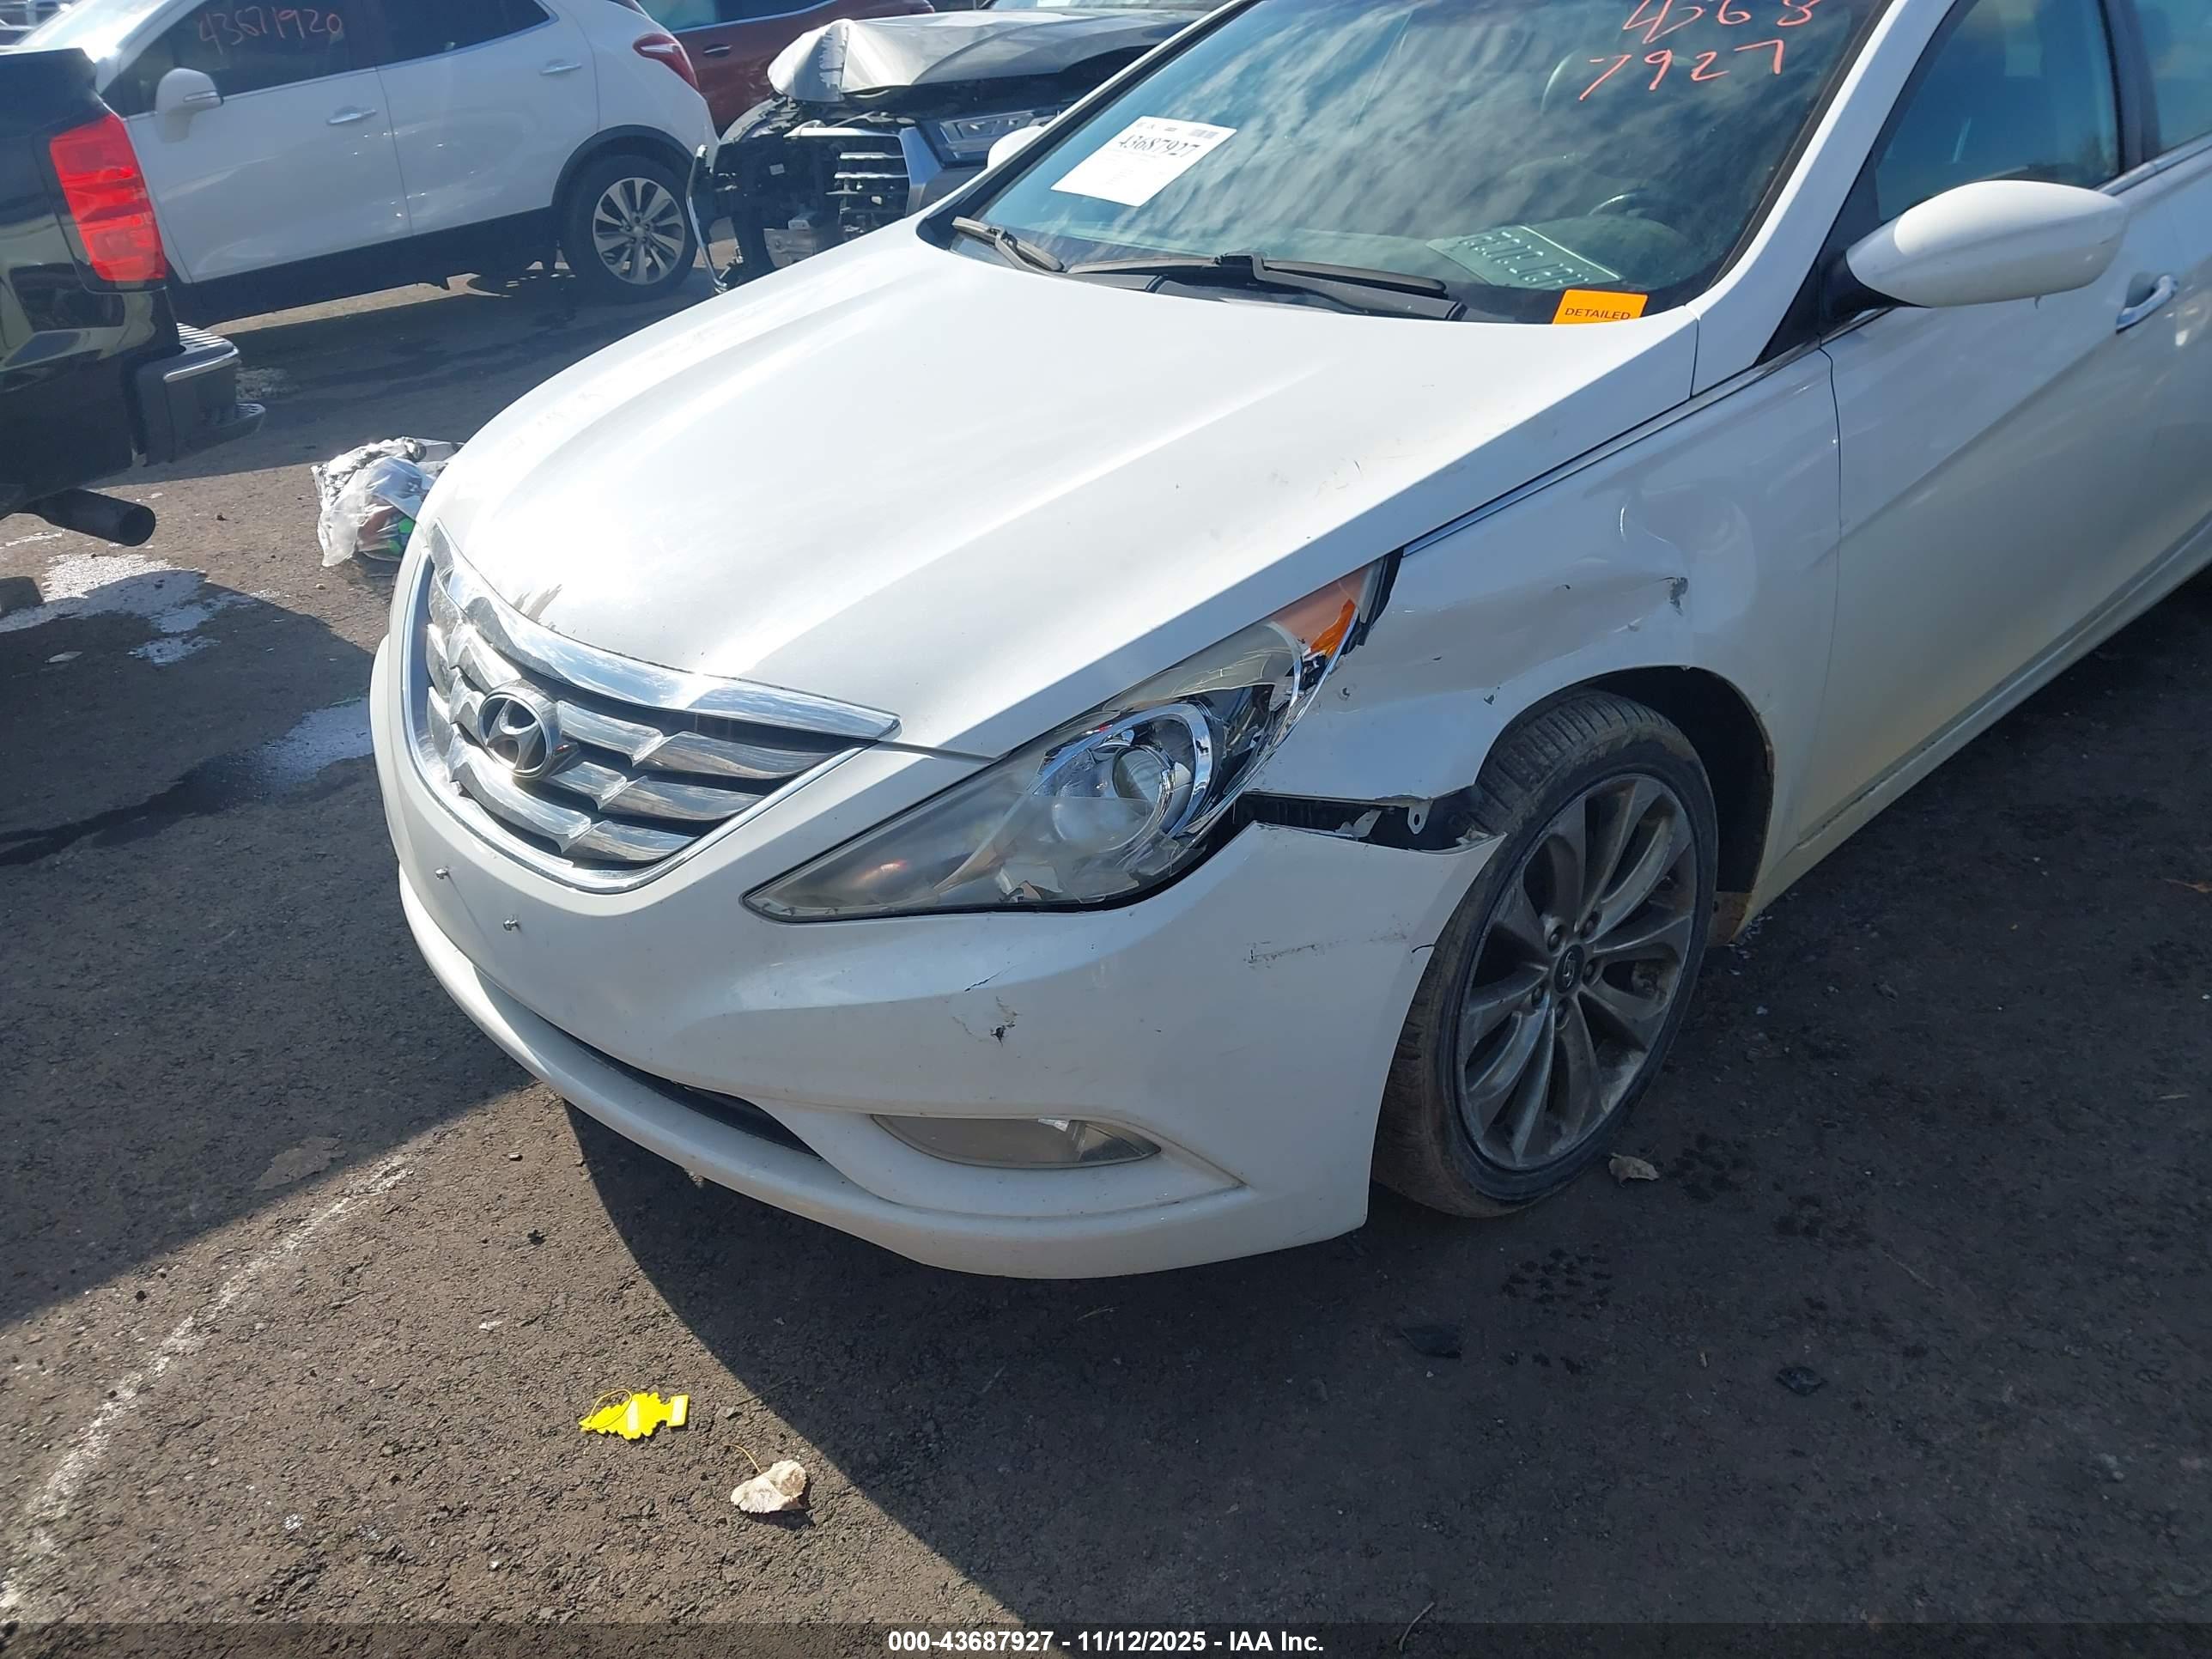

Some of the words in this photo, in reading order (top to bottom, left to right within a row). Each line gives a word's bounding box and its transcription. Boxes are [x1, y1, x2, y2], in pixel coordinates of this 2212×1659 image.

[1579, 39, 1784, 101] 7927
[1119, 135, 1201, 158] 43687927
[1565, 307, 1632, 320] DETAILED
